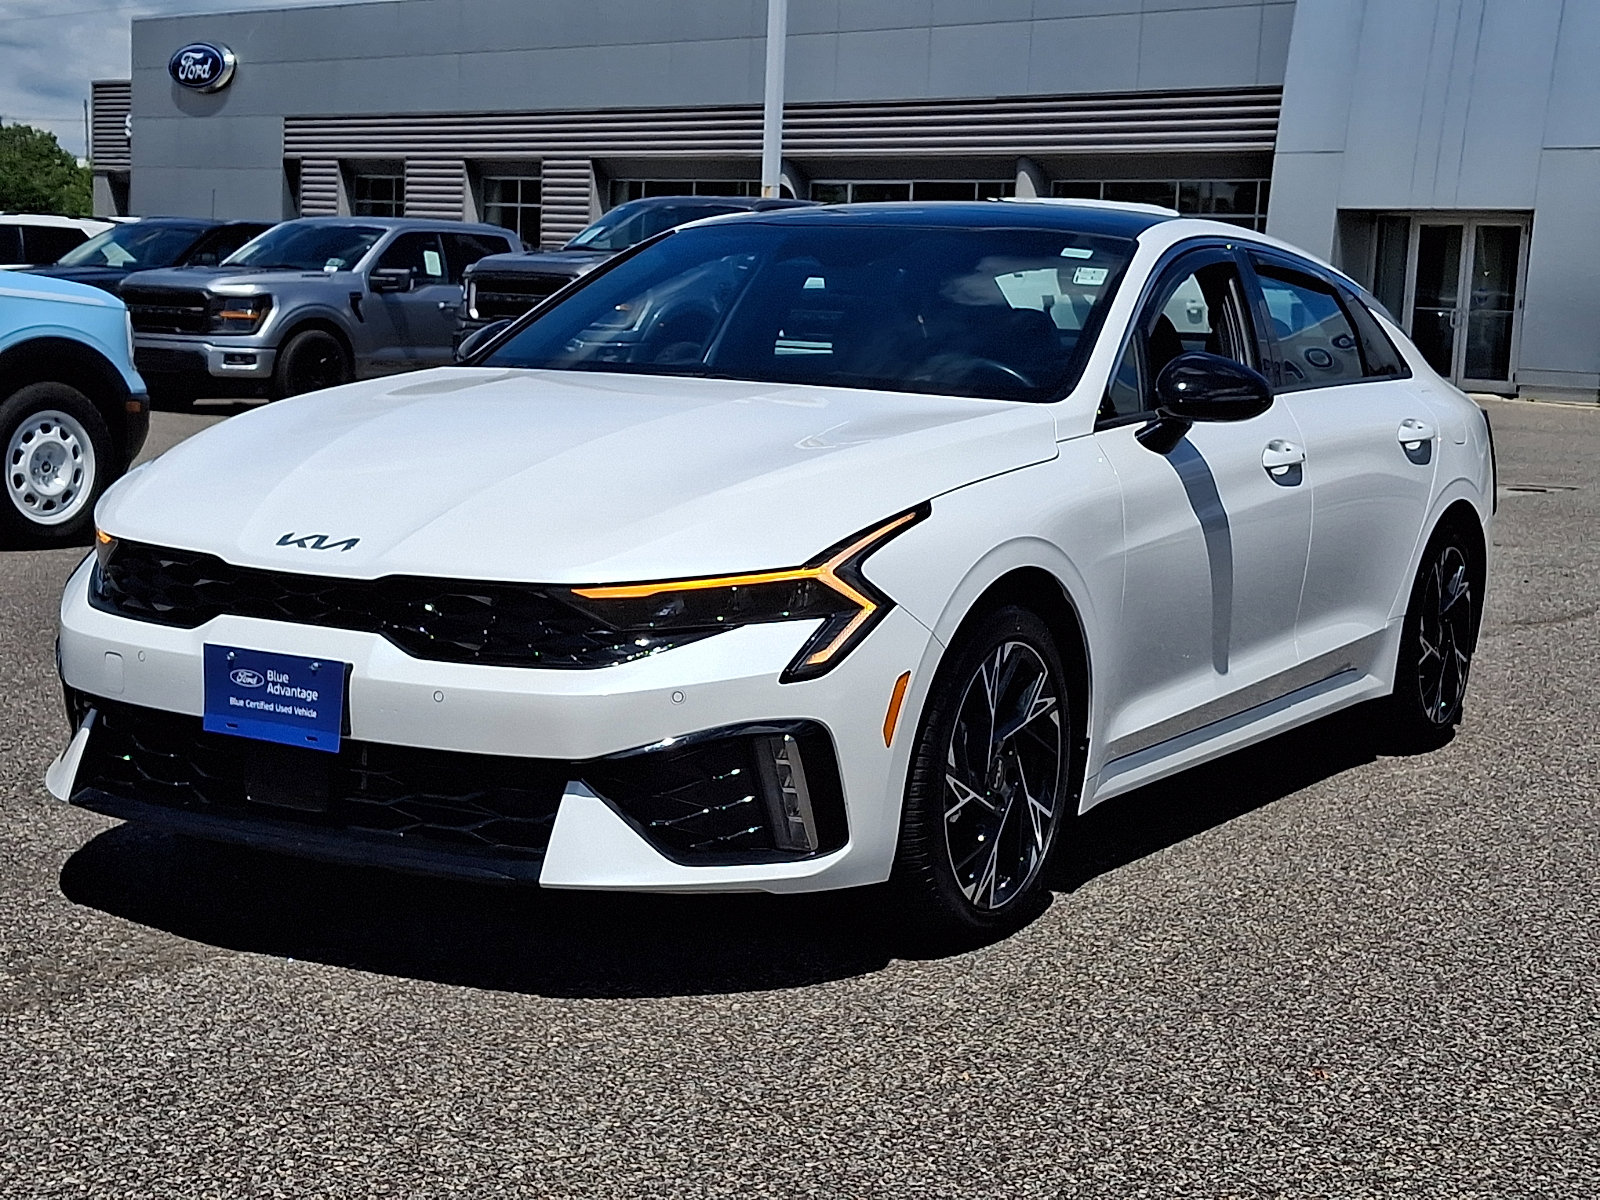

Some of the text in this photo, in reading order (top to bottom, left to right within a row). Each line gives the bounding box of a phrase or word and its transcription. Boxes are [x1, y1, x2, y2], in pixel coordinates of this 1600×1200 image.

[178, 51, 213, 80] Ford
[275, 532, 361, 552] KIA
[267, 670, 289, 683] Blue
[267, 683, 318, 702] Advantage
[229, 697, 317, 718] Blue Certified Used Vehicle
